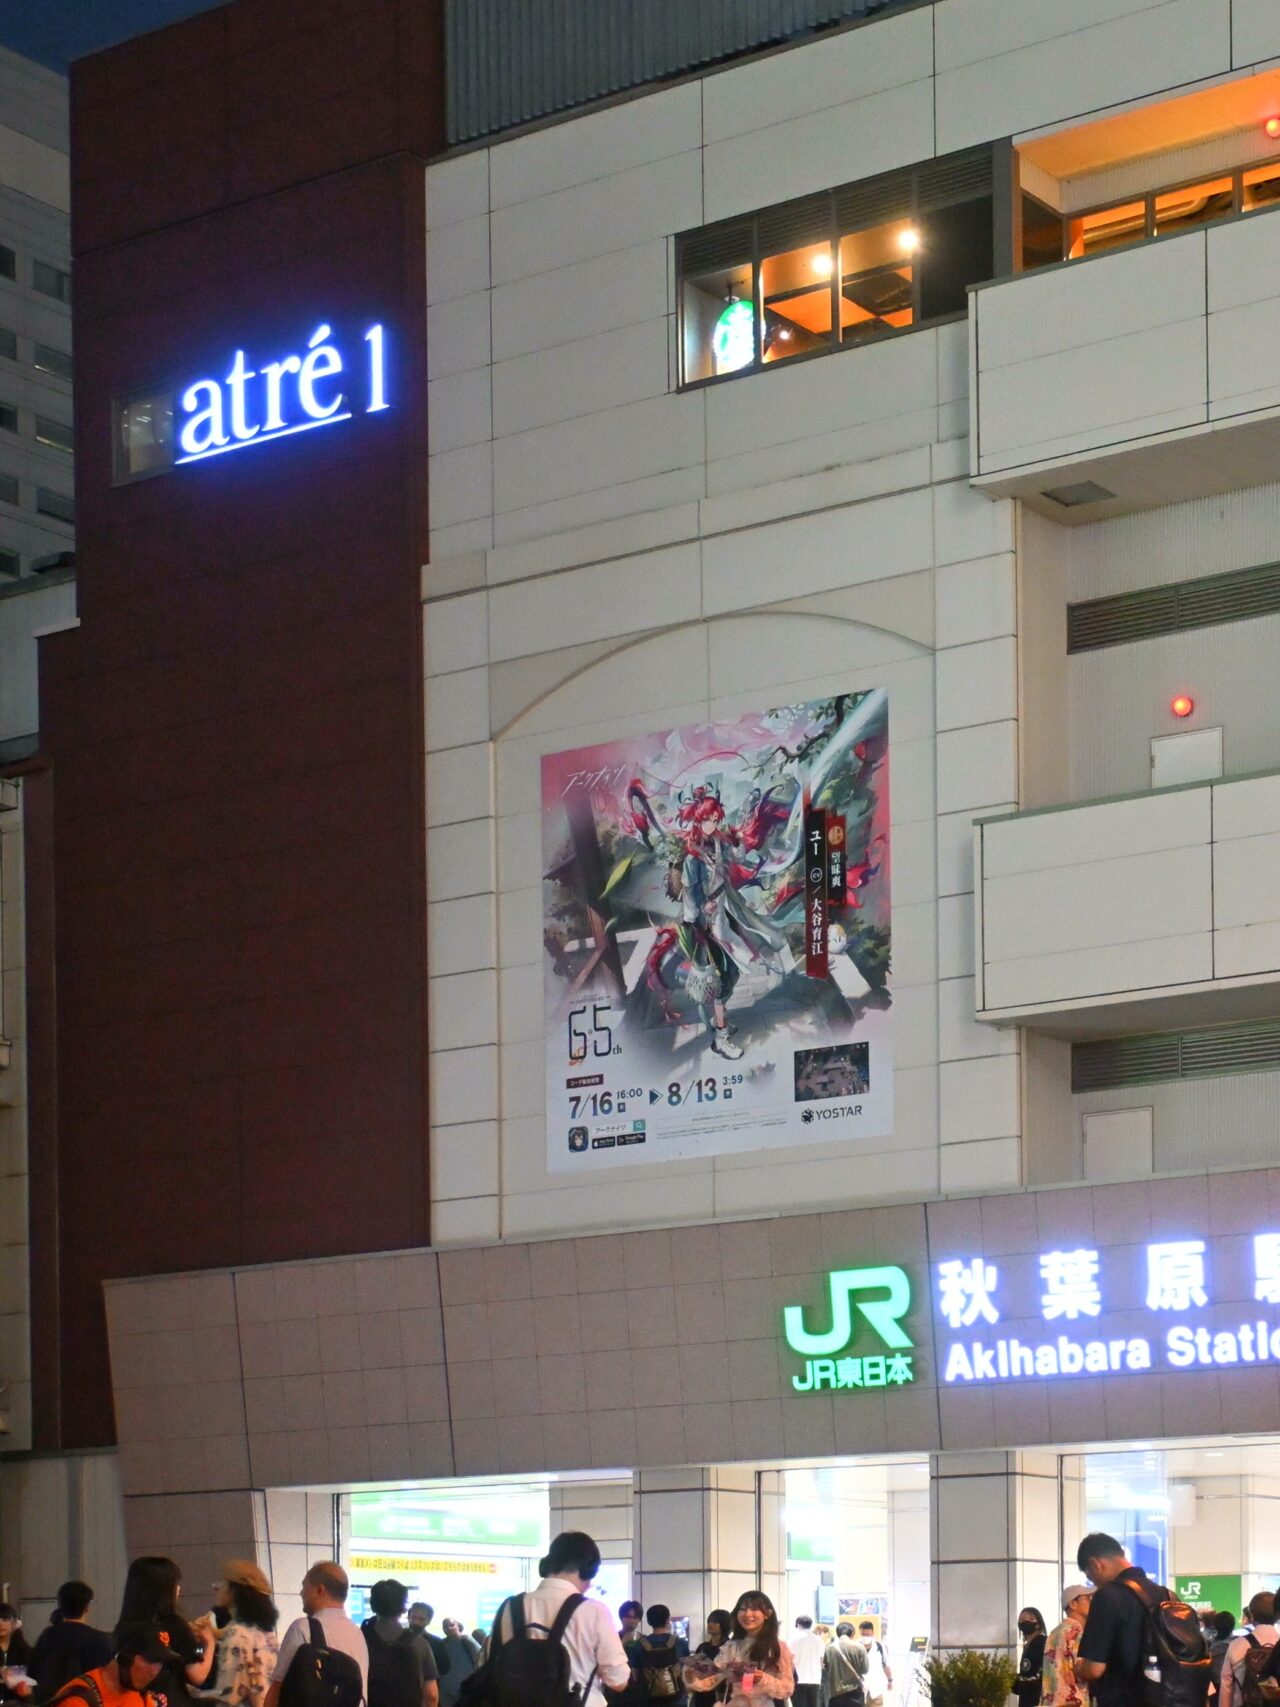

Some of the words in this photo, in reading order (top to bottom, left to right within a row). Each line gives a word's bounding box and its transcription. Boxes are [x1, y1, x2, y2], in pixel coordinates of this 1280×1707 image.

[180, 324, 344, 455] atré
[364, 322, 391, 413] 1
[811, 898, 824, 956] 大谷育江
[569, 1091, 613, 1119] 7/16
[616, 1088, 643, 1100] 16:00
[667, 1077, 718, 1106] 8/13
[722, 1074, 744, 1086] 3:59
[816, 1105, 863, 1121] YOSTAR
[784, 1266, 914, 1356] JR
[792, 1355, 914, 1391] JR東日本
[945, 1336, 1151, 1382] Akihabara
[1181, 1582, 1201, 1595] JR
